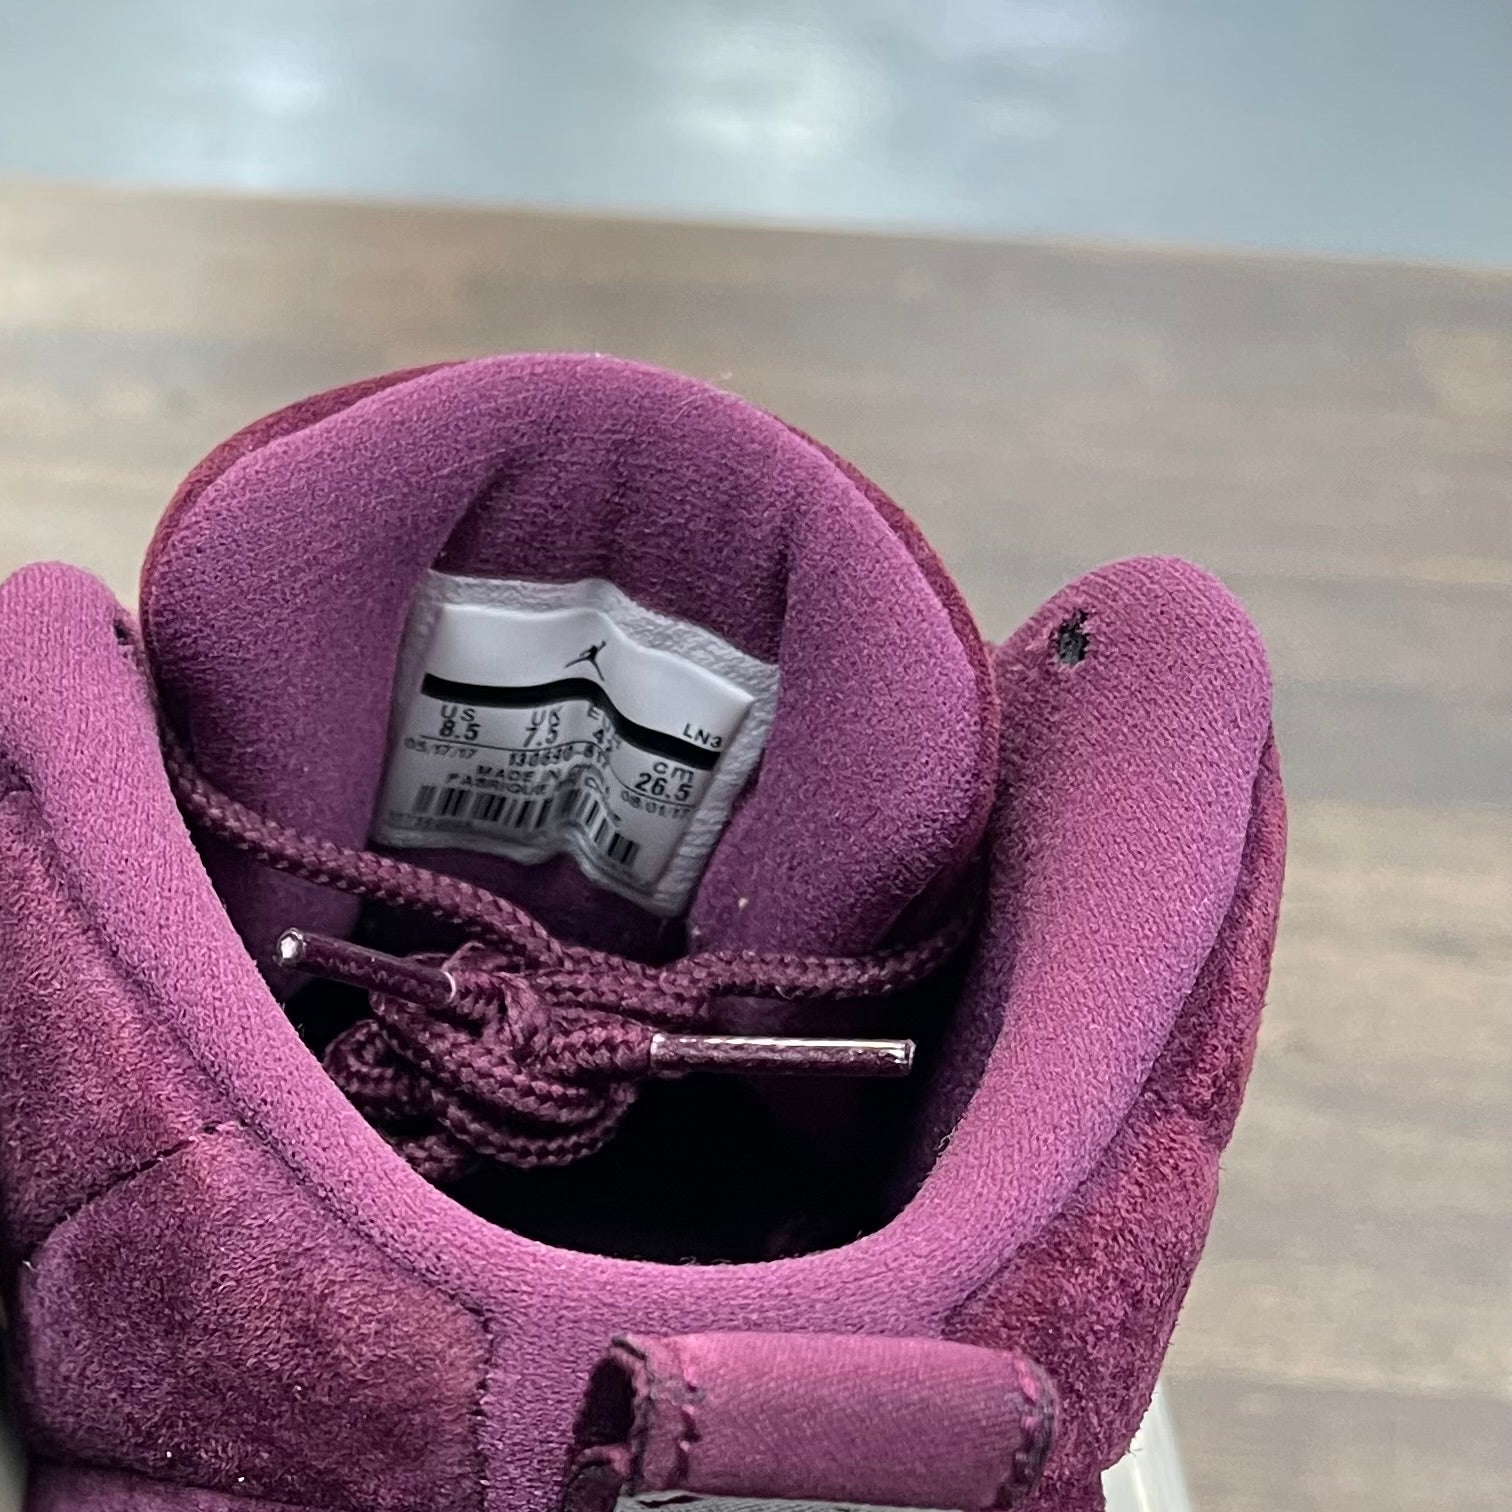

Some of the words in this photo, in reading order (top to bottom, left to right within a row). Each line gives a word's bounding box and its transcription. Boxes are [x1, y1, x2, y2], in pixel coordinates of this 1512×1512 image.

[440, 704, 477, 722] US
[683, 722, 722, 749] LN3
[438, 718, 481, 741] 8.5
[522, 724, 559, 748] 7.5
[634, 772, 693, 802] 26.5
